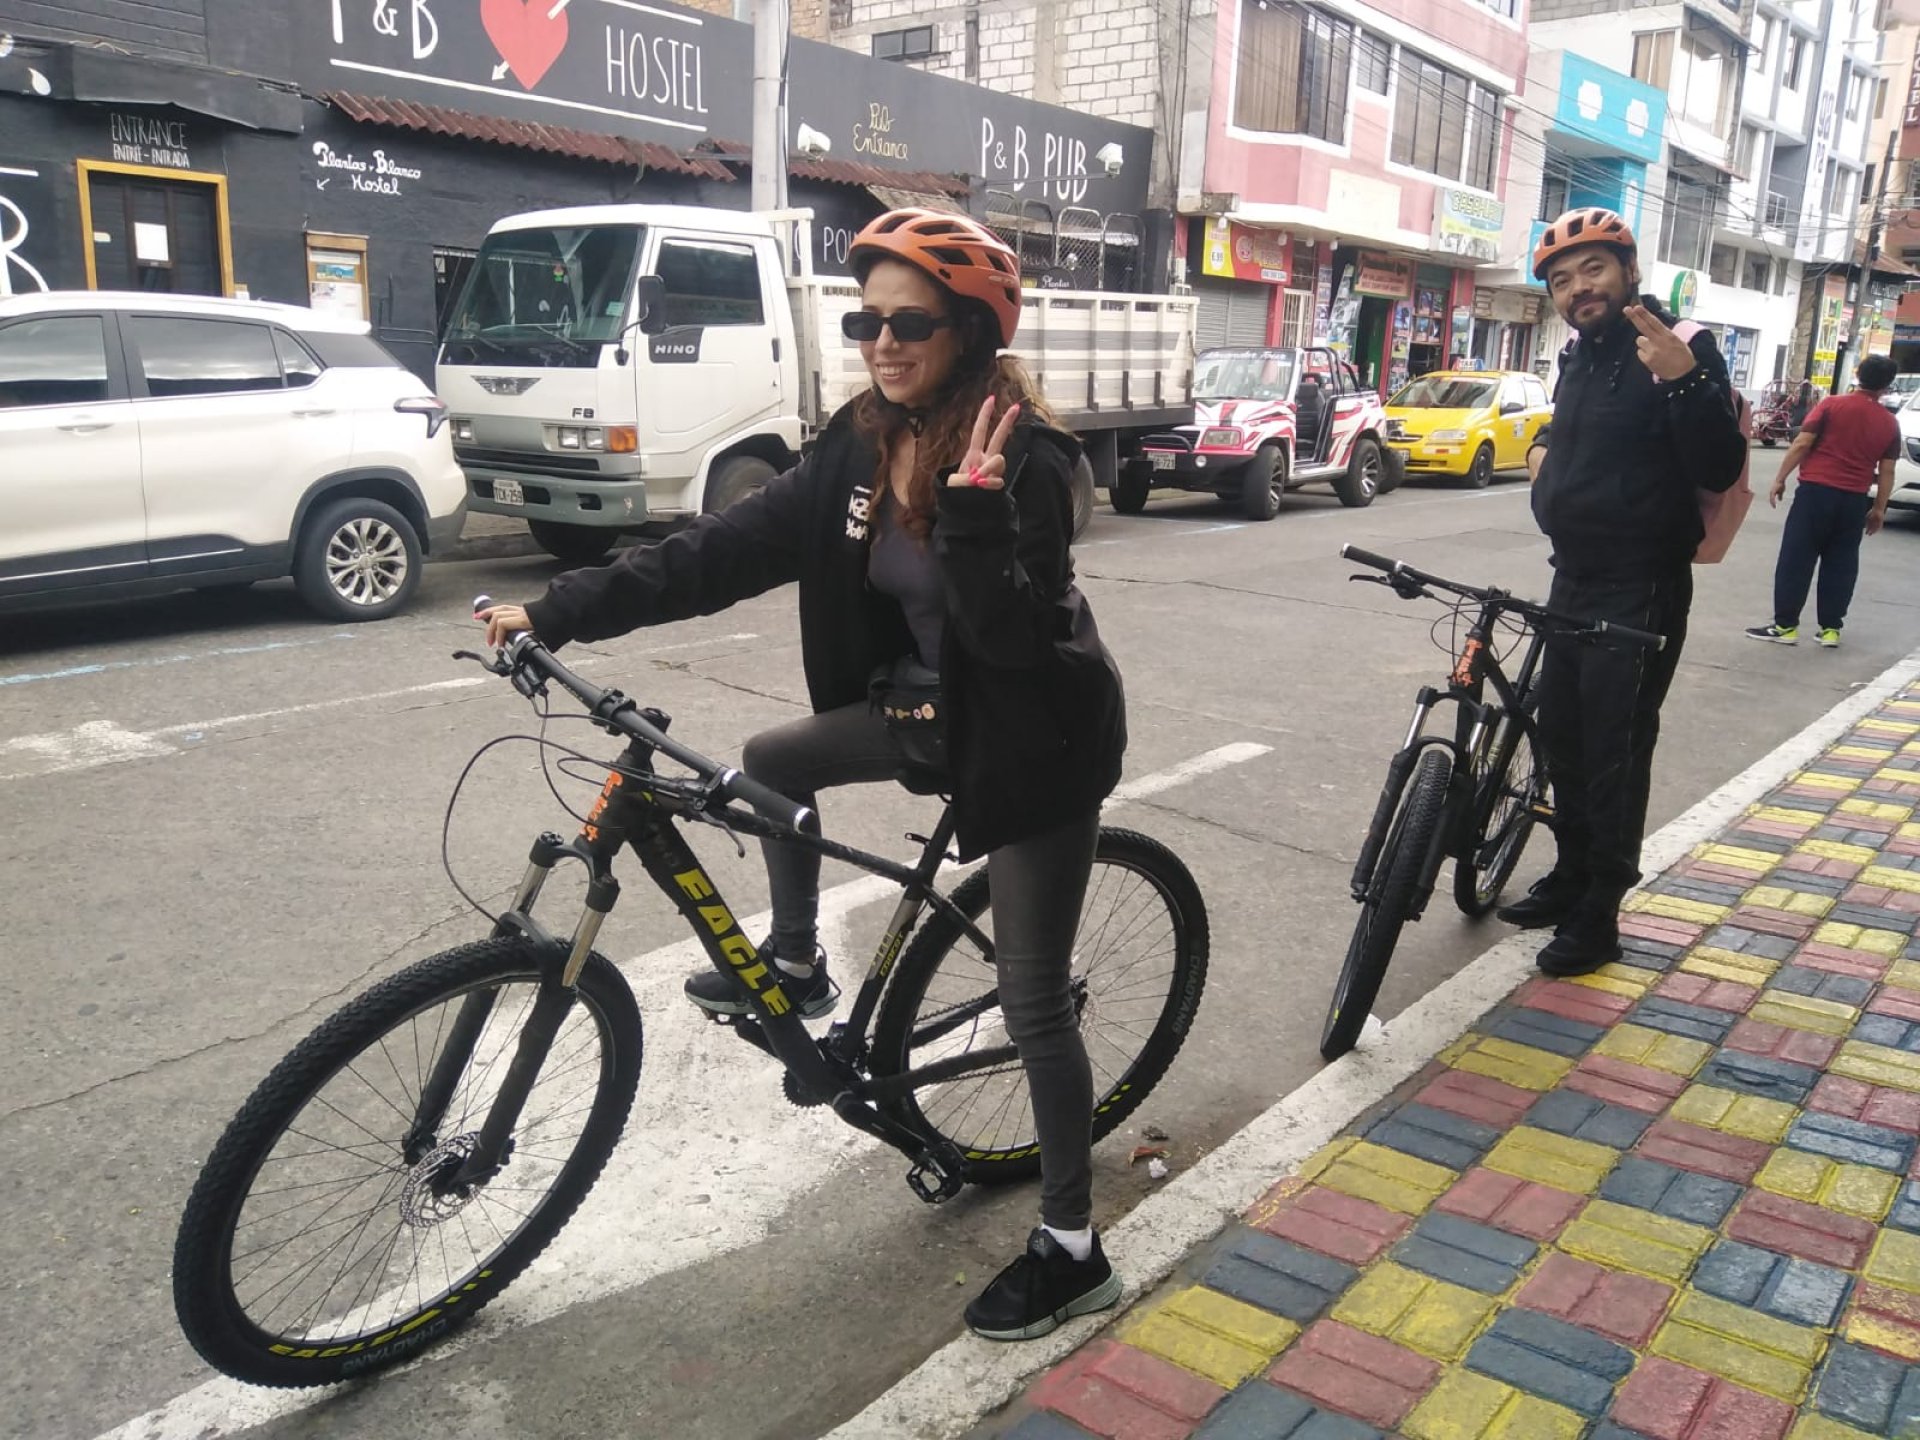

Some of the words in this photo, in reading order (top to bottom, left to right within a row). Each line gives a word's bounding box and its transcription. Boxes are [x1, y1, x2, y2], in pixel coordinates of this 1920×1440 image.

[606, 24, 708, 113] HOSTEL
[111, 113, 188, 150] ENTRANCE
[869, 102, 896, 133] Pub
[853, 123, 909, 161] Entrance
[982, 117, 994, 179] P
[994, 141, 1008, 169] &
[1013, 125, 1030, 192] B
[1044, 132, 1088, 203] PUB
[373, 150, 421, 179] Blanco
[351, 174, 402, 196] Hostel
[655, 345, 696, 355] HINO
[673, 868, 792, 1017] EAGLE
